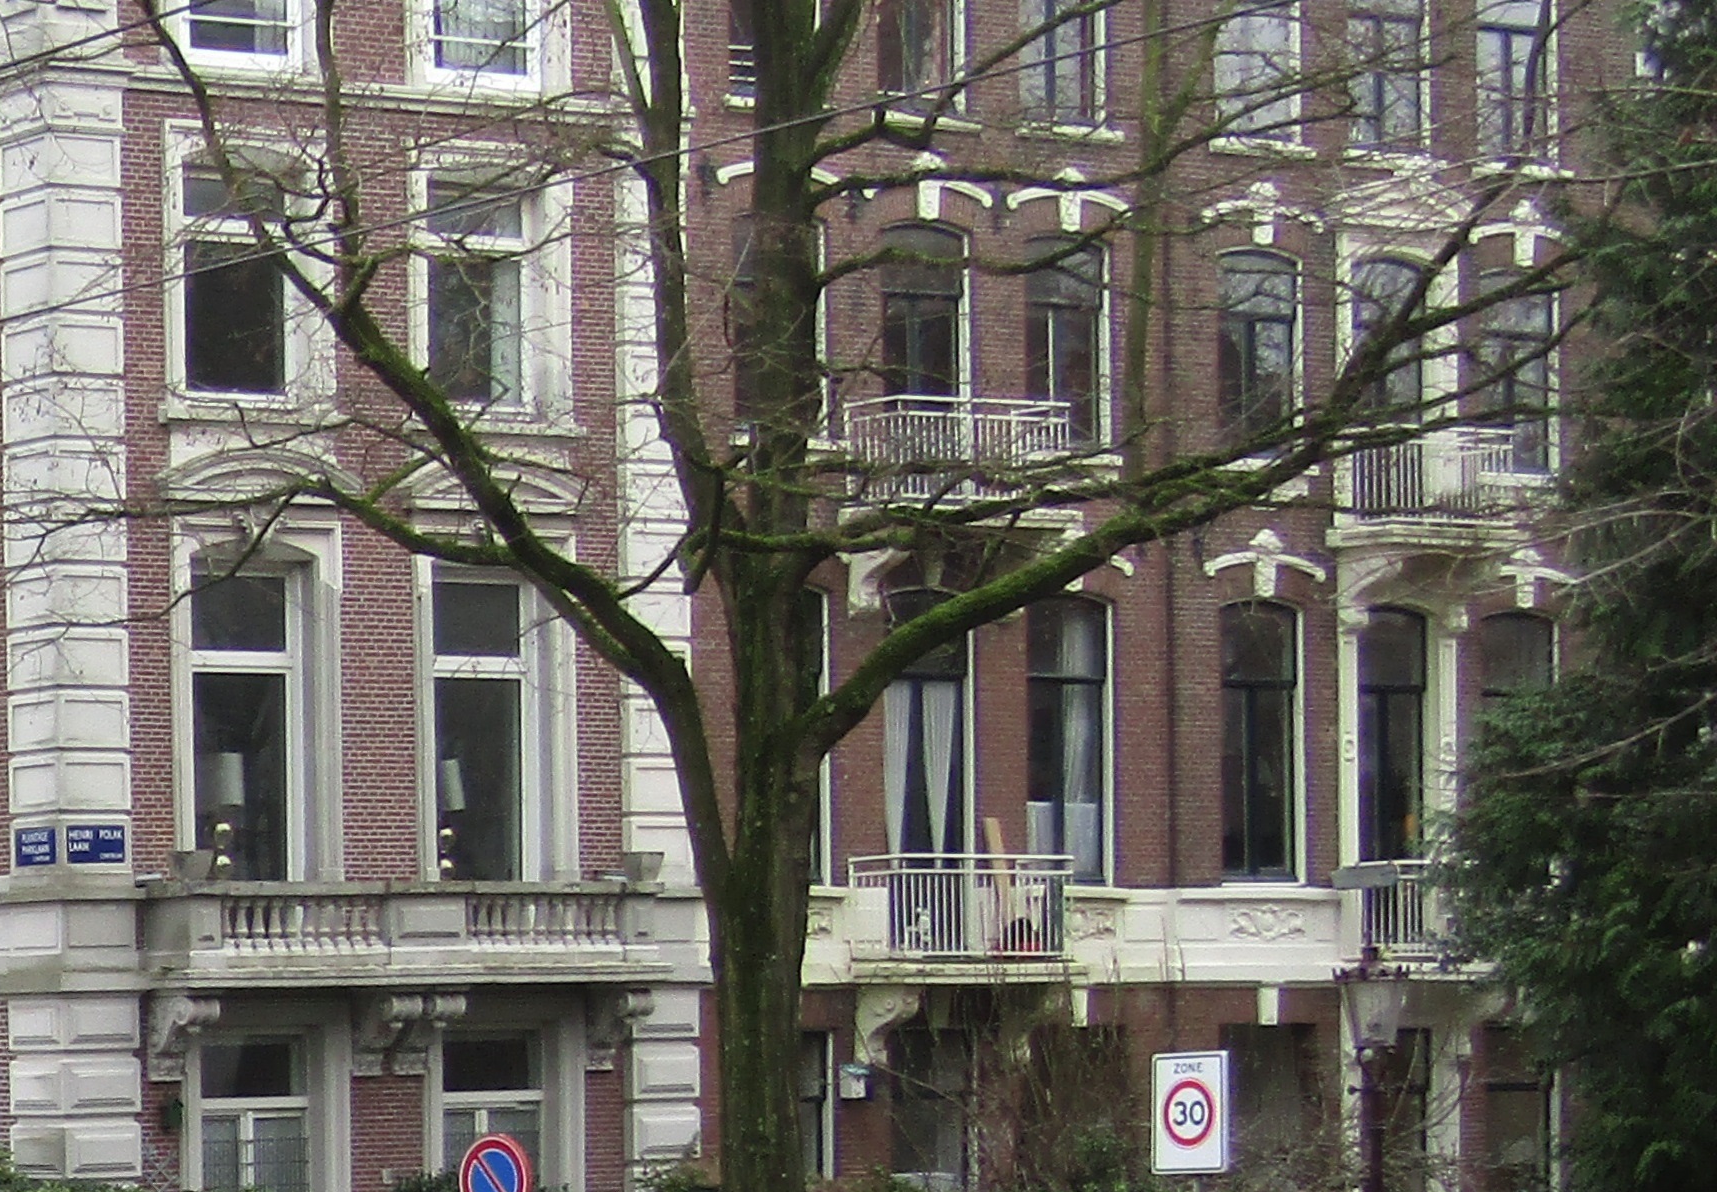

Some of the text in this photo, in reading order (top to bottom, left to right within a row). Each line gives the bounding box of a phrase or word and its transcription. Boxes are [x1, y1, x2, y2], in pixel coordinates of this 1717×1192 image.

[68, 841, 90, 852] LAAN
[1173, 1062, 1204, 1074] ZONE
[1172, 1100, 1206, 1127] 30
